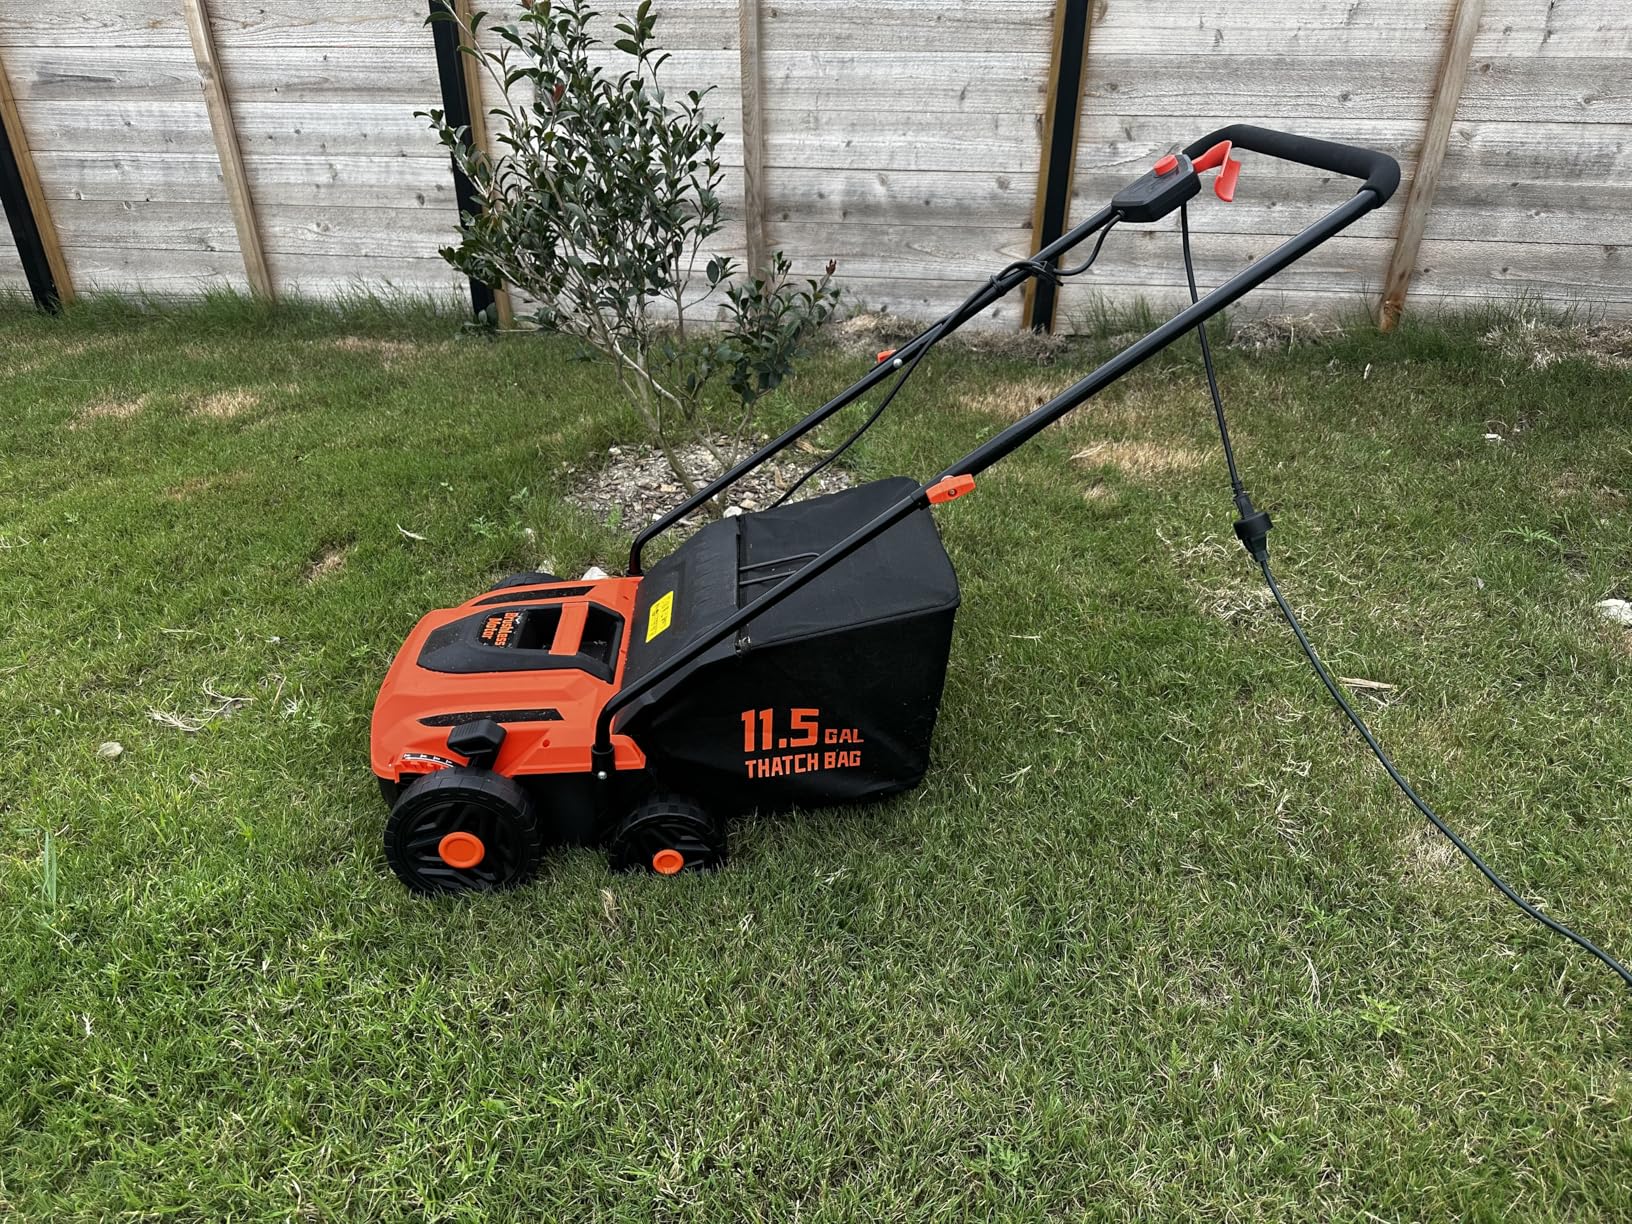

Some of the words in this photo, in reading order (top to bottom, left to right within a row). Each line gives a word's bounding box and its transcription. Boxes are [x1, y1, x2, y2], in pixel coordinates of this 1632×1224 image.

[481, 617, 502, 640] Motor
[494, 612, 519, 647] Brushless
[741, 708, 820, 753] 11.5
[824, 728, 865, 744] GAL
[745, 752, 819, 779] THATCH
[824, 750, 862, 769] BAG
